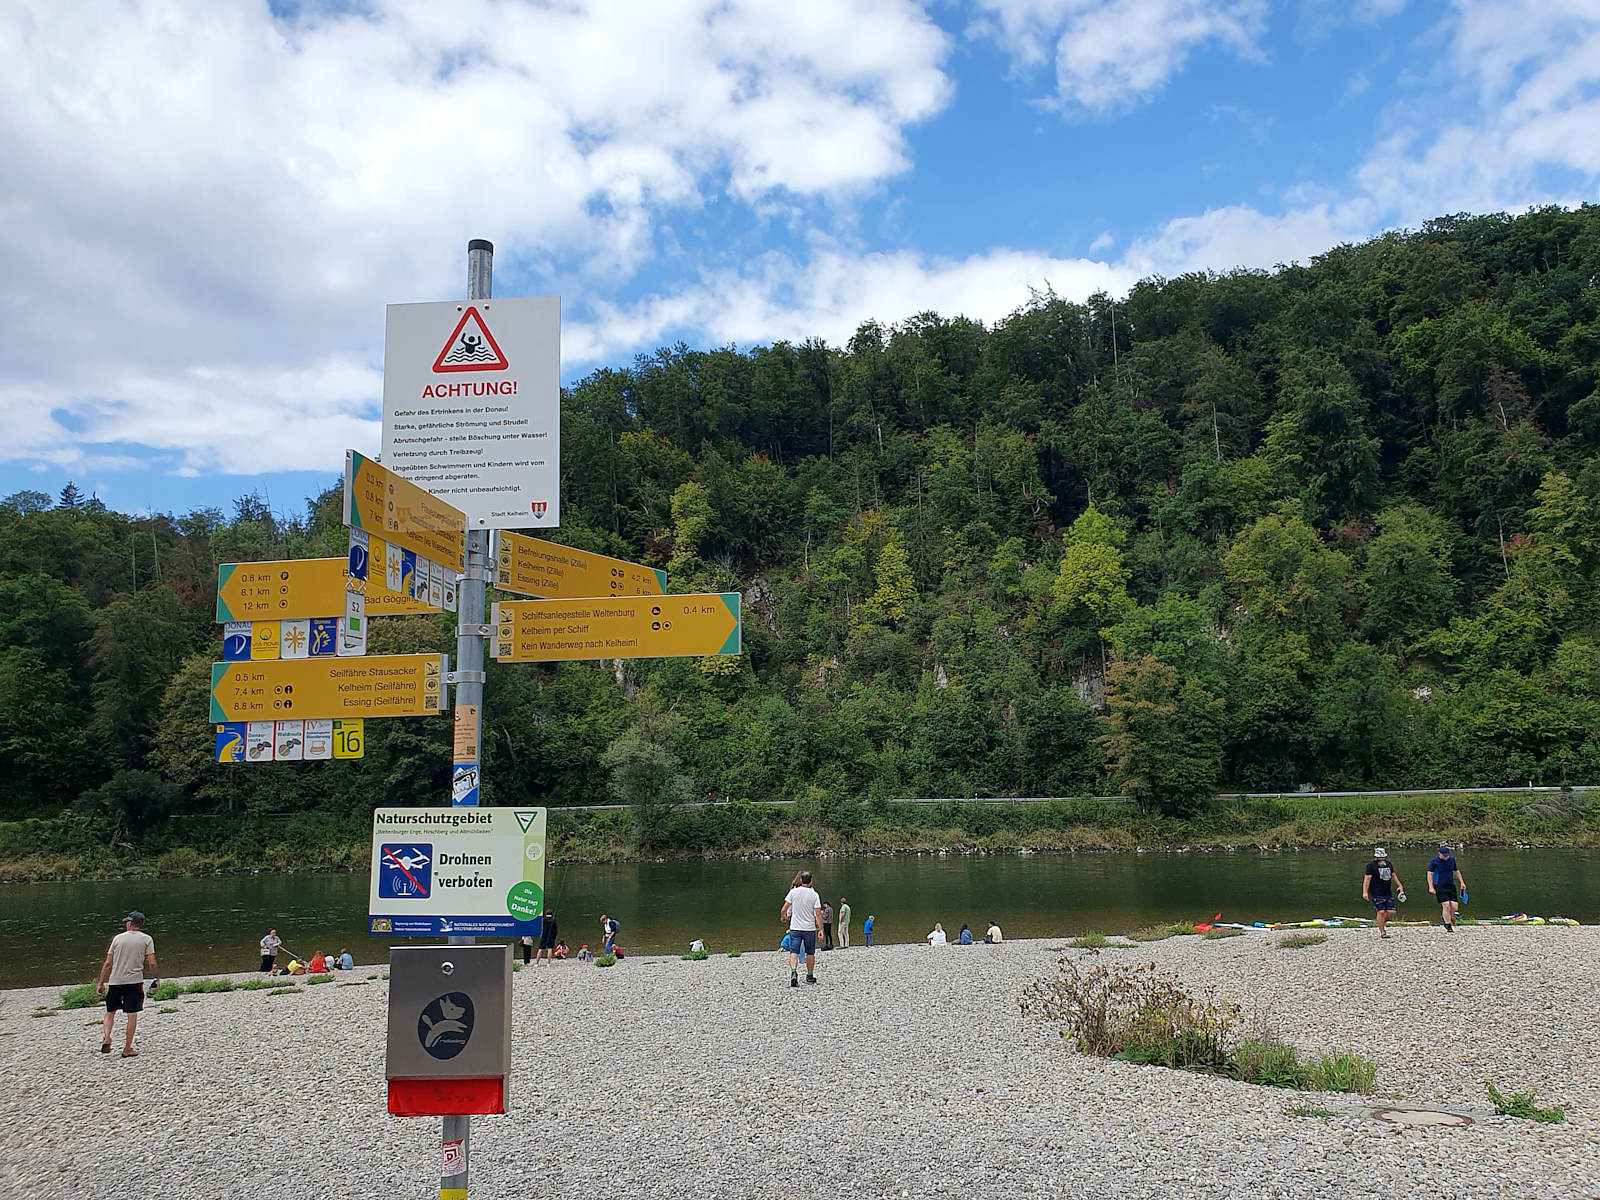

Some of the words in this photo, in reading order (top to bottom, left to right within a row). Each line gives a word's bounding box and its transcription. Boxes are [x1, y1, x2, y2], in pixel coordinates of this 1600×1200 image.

[422, 381, 517, 398] ACHTUNG!
[394, 409, 416, 417] Gefahr
[418, 421, 454, 430] gefährliche
[455, 420, 488, 428] Strömung
[393, 436, 443, 445] Abrutschgefahr
[449, 448, 483, 456] Treibzeug!
[392, 464, 428, 472] Ungeübten
[414, 474, 443, 482] dringend
[445, 472, 480, 480] abgeraten.
[451, 486, 468, 494] nicht
[469, 485, 522, 493] unbeaufsichtigt.
[517, 559, 546, 573] Kelheim
[518, 545, 569, 565] Befreiungshalle
[642, 576, 652, 585] km
[258, 573, 271, 582] km
[517, 573, 540, 587] Essing
[257, 587, 270, 596] km
[244, 602, 253, 611] 12
[256, 601, 269, 610] km
[522, 610, 591, 620] Schiffsanlegestelle
[592, 609, 635, 618] Weltenburg
[683, 606, 697, 615] 0.4
[701, 605, 715, 614] km
[521, 626, 552, 635] Kelheim
[553, 627, 565, 636] per
[567, 625, 589, 634] Schiff
[521, 642, 537, 650] Kein
[539, 640, 583, 650] Wanderweg
[585, 639, 604, 648] nach
[605, 638, 638, 647] Kelheim!
[235, 673, 249, 682] 0.5
[251, 672, 265, 681] km
[330, 668, 366, 678] Seilfähre
[369, 666, 416, 677] Stausacker
[235, 687, 248, 696] 7.4
[251, 687, 264, 696] km
[338, 683, 372, 692] Kelheim
[374, 681, 416, 692] (Seilfähre)
[234, 702, 247, 711] 8.8
[250, 701, 264, 710] km
[343, 697, 372, 707] Essing
[374, 695, 416, 706] (Seilfähre)
[336, 730, 360, 753] 16
[376, 813, 492, 827] Naturschutzgebiet
[439, 853, 492, 866] Drohnen
[438, 876, 493, 888] verboten
[511, 903, 537, 915] Danke!
